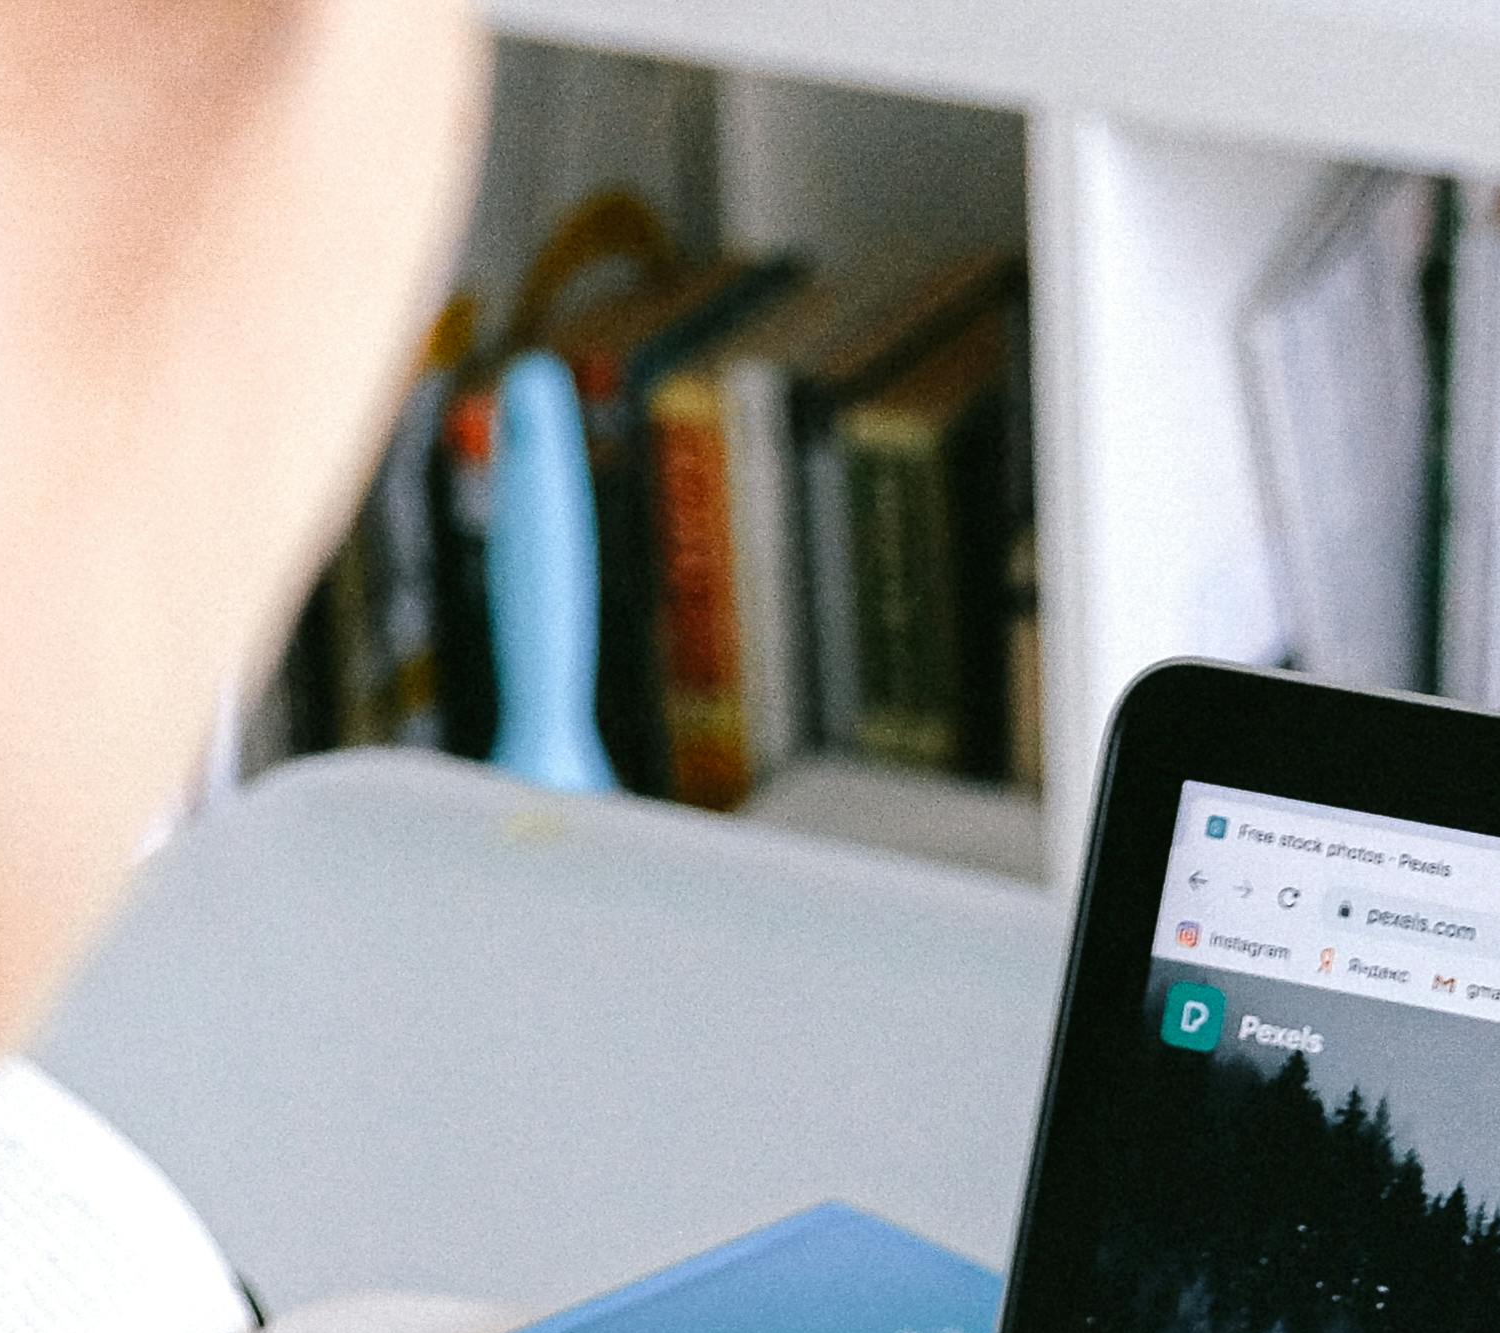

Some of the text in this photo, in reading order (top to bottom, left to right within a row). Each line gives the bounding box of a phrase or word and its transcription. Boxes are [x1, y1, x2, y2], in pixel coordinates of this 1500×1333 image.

[1238, 823, 1276, 845] Free
[1279, 833, 1322, 854] stock
[1325, 842, 1386, 866] photos
[1398, 853, 1453, 878] Pexels
[1366, 907, 1477, 941] pexels.com
[1237, 1014, 1326, 1054] Pexels
